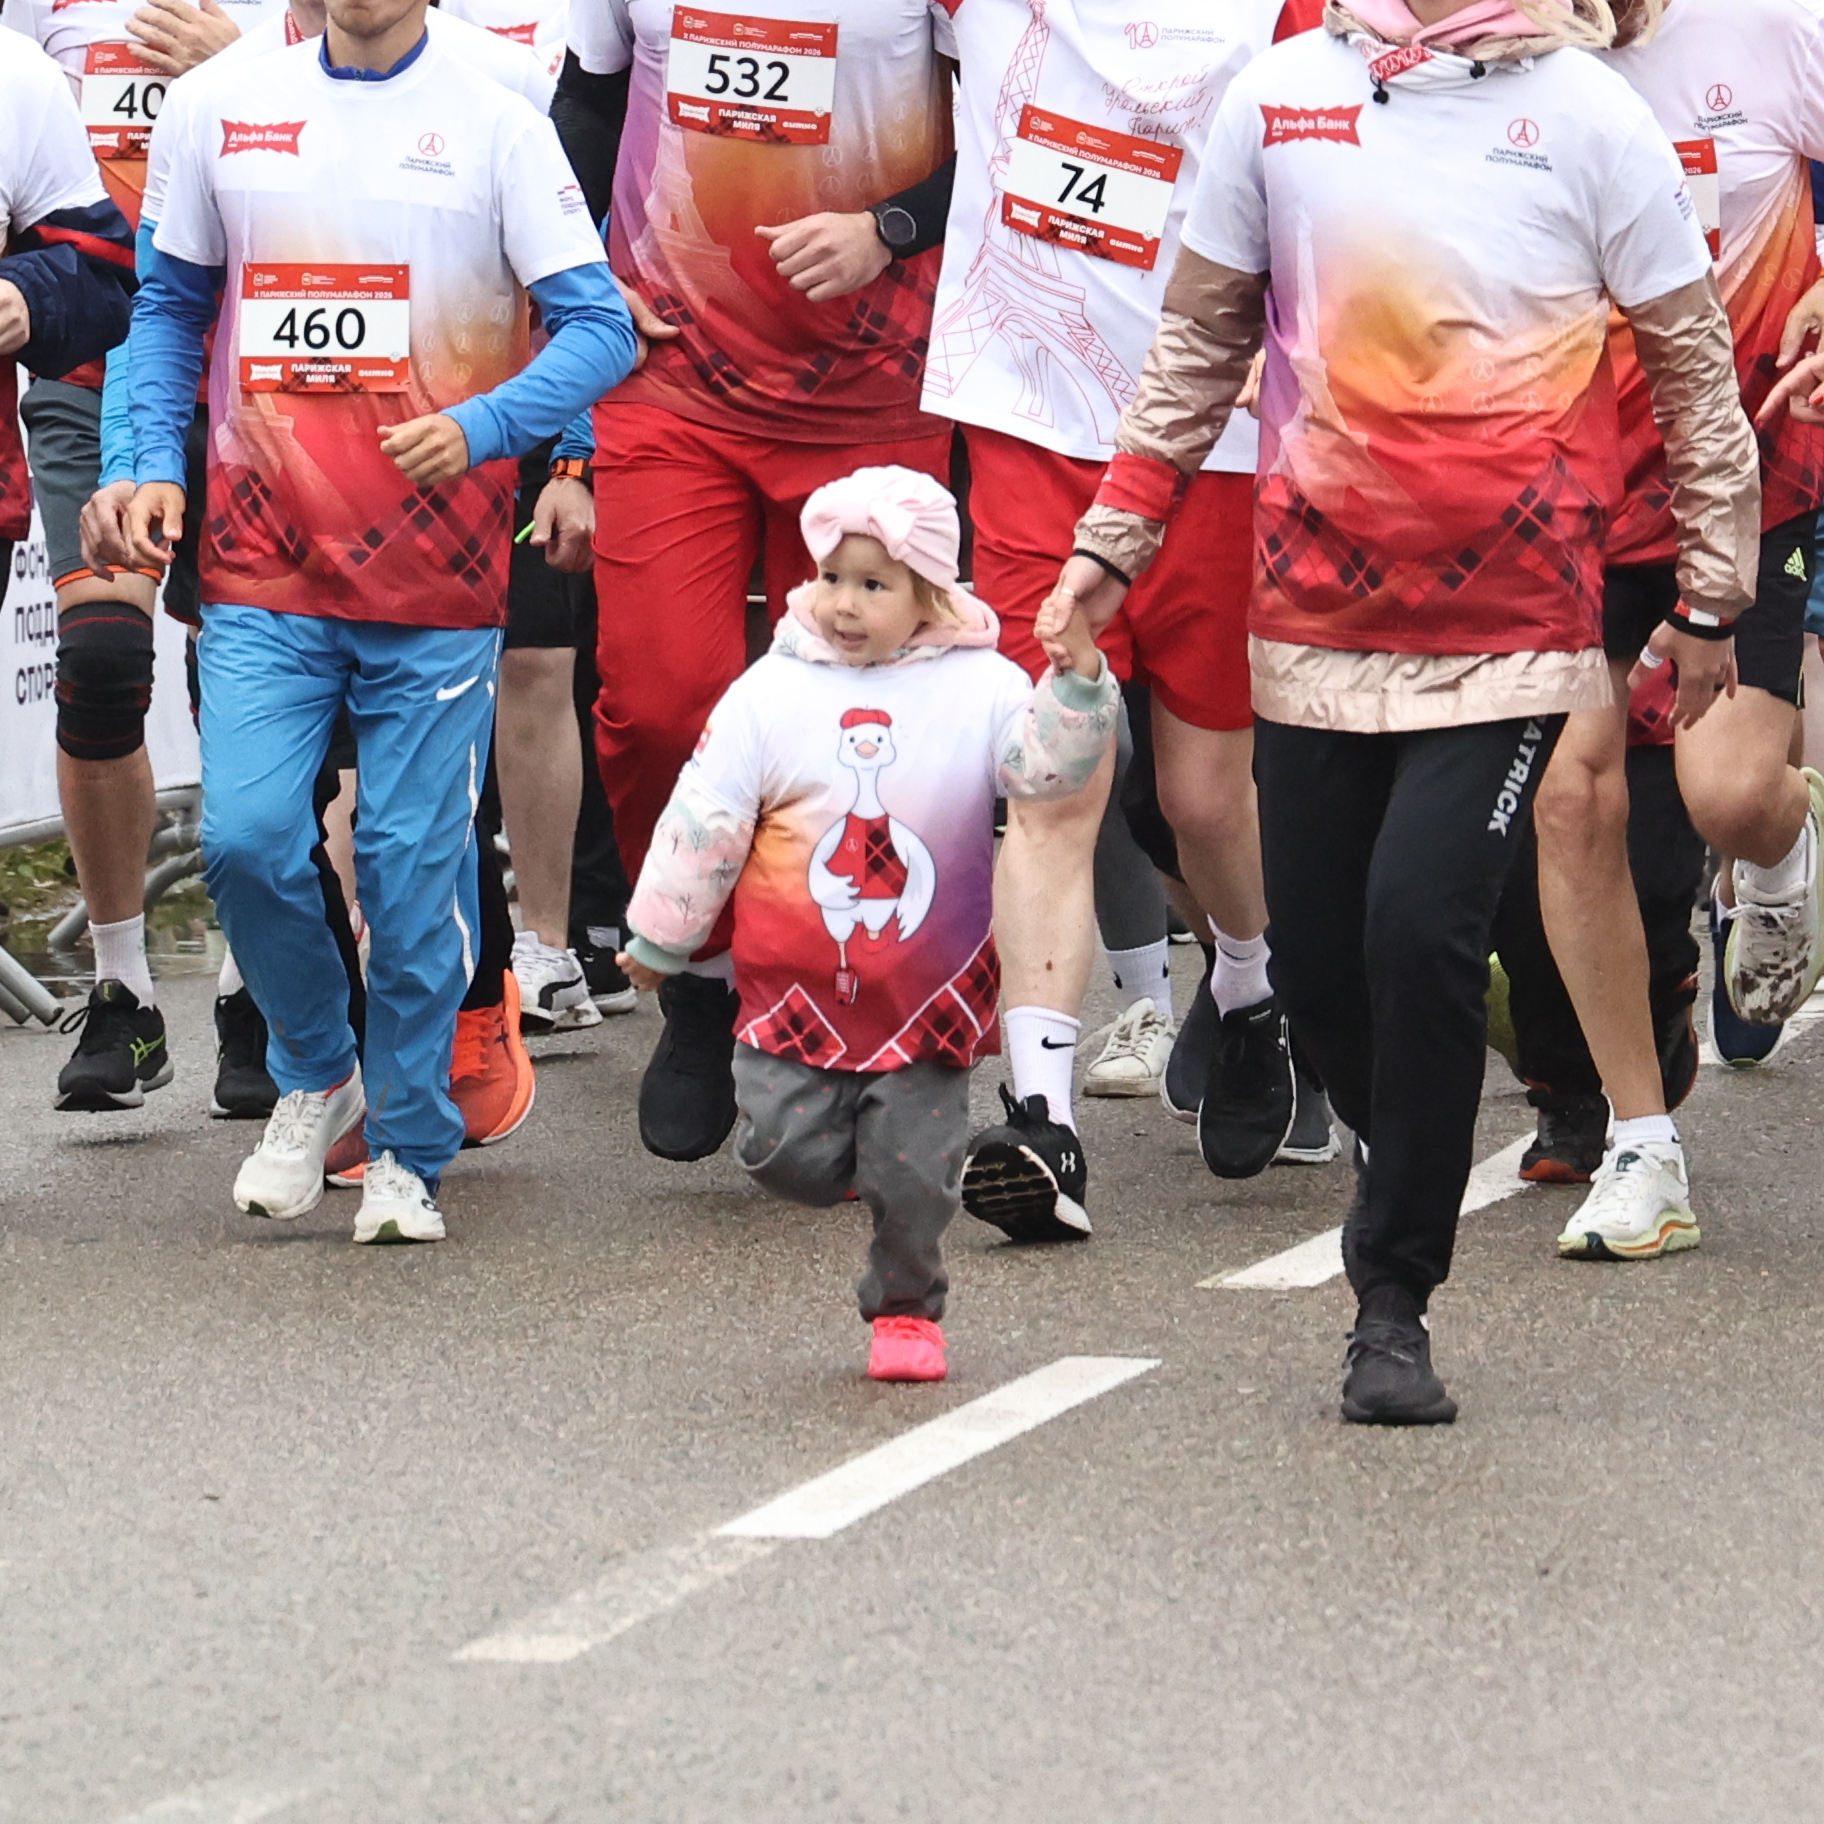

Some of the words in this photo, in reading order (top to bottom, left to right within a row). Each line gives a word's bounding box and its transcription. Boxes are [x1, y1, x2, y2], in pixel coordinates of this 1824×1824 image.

[705, 54, 790, 102] 532
[113, 82, 166, 120] 40
[229, 131, 263, 143] Альфа
[264, 130, 293, 143] Банк
[1272, 117, 1314, 131] Альфа
[1317, 116, 1350, 131] Банк
[1057, 162, 1108, 214] 74
[273, 307, 366, 350] 460
[15, 542, 51, 585] ФОН
[15, 661, 59, 705] СПОР
